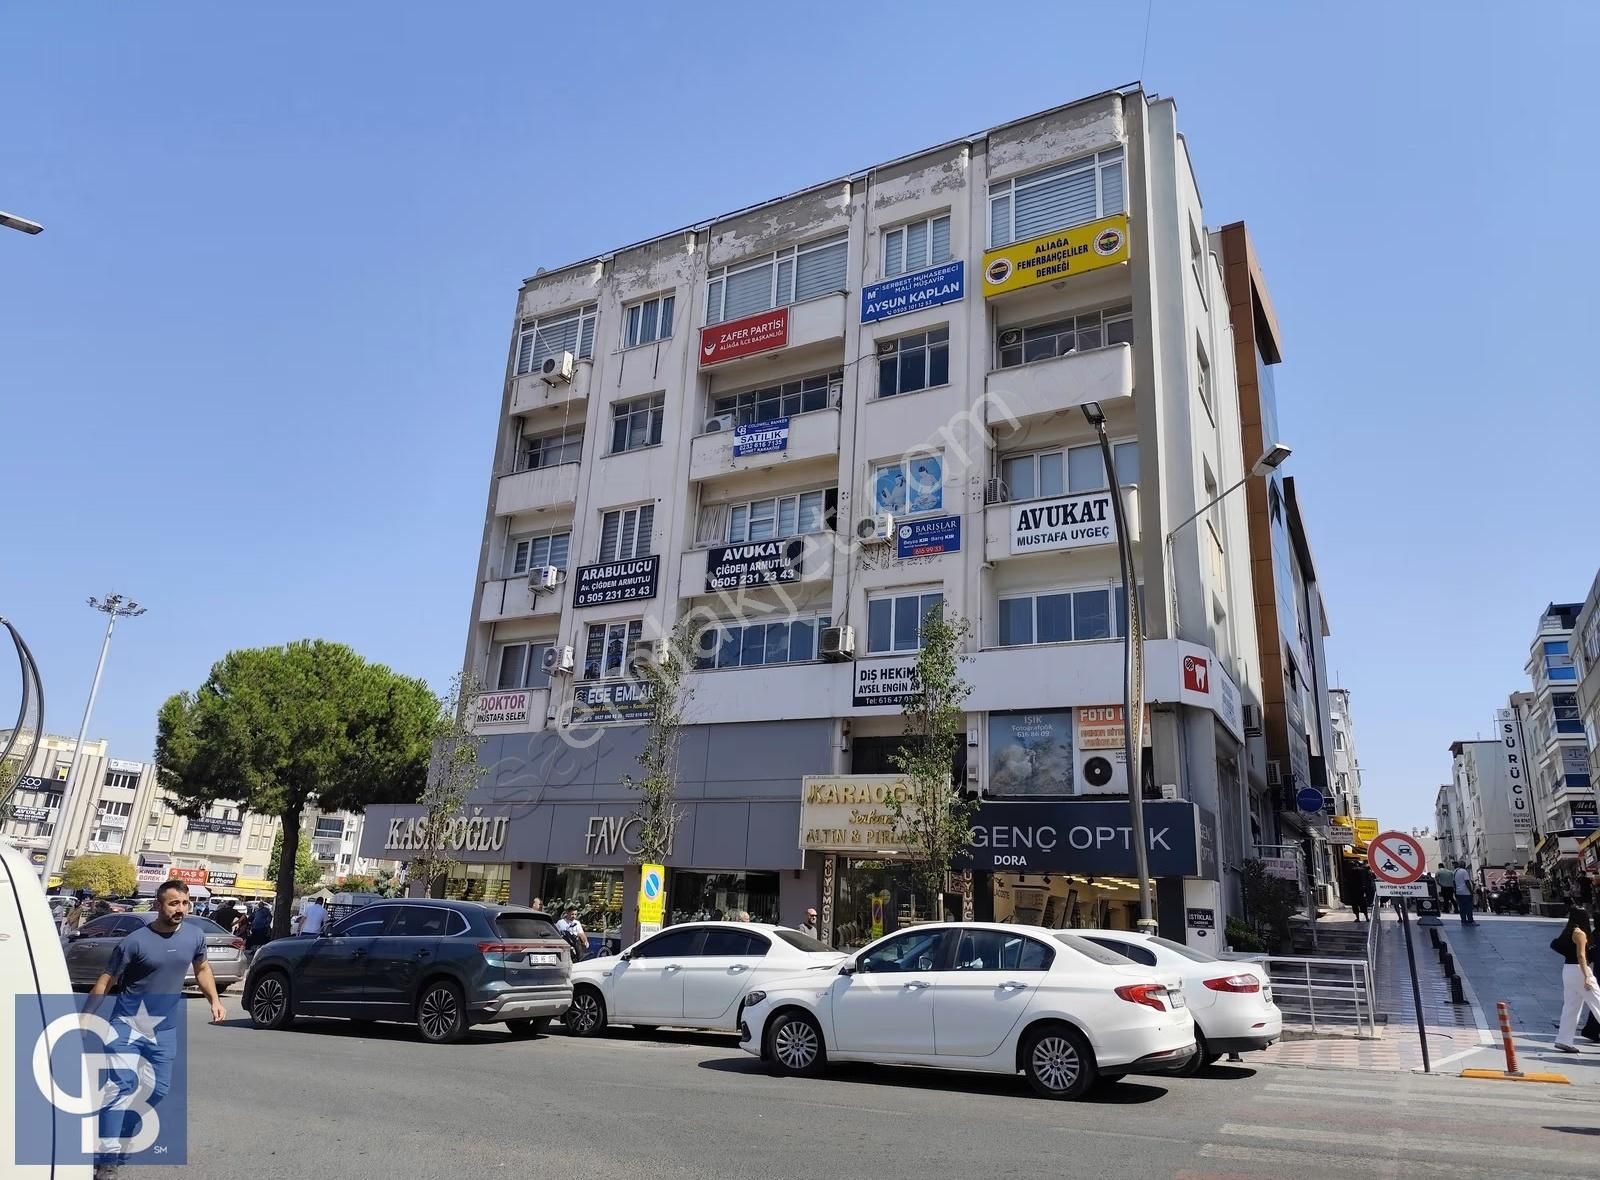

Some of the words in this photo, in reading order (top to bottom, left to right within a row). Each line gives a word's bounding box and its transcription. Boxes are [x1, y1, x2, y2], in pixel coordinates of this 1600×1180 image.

[1035, 238, 1069, 253] ALİAĞA
[1017, 244, 1089, 270] FENERBAHÇELİLER
[882, 278, 911, 290] SERBEST
[914, 264, 958, 282] MUHASEBECİ
[1036, 262, 1070, 278] DERNEĞİ
[866, 296, 906, 314] AYSUN
[910, 282, 960, 303] KAPLAN
[720, 329, 748, 343] ZAFER
[750, 317, 784, 335] PARTİSİ
[740, 430, 782, 444] SATILIK
[1017, 499, 1108, 531] AVUKAT
[1017, 532, 1067, 546] MUSTAFA
[1071, 526, 1110, 539] UYGEÇ
[722, 542, 786, 562] AVUKAT
[582, 560, 652, 580] ARABULUCU
[716, 563, 748, 577] ÇİĞDEM
[749, 558, 791, 572] ARMUTLU
[592, 580, 616, 592] ÇİĞDEM
[618, 576, 650, 586] ARMUTLU
[711, 577, 736, 588] 0505
[740, 574, 759, 584] 231
[764, 571, 776, 582] 23
[780, 569, 794, 579] 43
[579, 595, 584, 604] 0
[587, 592, 603, 602] 505
[606, 590, 622, 600] 231
[624, 588, 636, 598] 23
[638, 586, 650, 595] 43
[588, 688, 611, 704] EGE
[615, 684, 655, 702] EMLAK
[859, 683, 880, 694] AYSEL
[882, 681, 908, 692] ENGİN
[481, 695, 525, 711] DOKTOR
[506, 712, 526, 720] SELEK
[1080, 708, 1114, 721] FOTO
[1504, 724, 1524, 810] SÜRÜCÜ
[806, 829, 847, 844] ALTIN
[852, 829, 860, 844] &
[969, 826, 1057, 852] GENÇ
[1068, 826, 1172, 850] OPTK
[994, 855, 1027, 866] DORA
[822, 860, 832, 923] KUYUMCU
